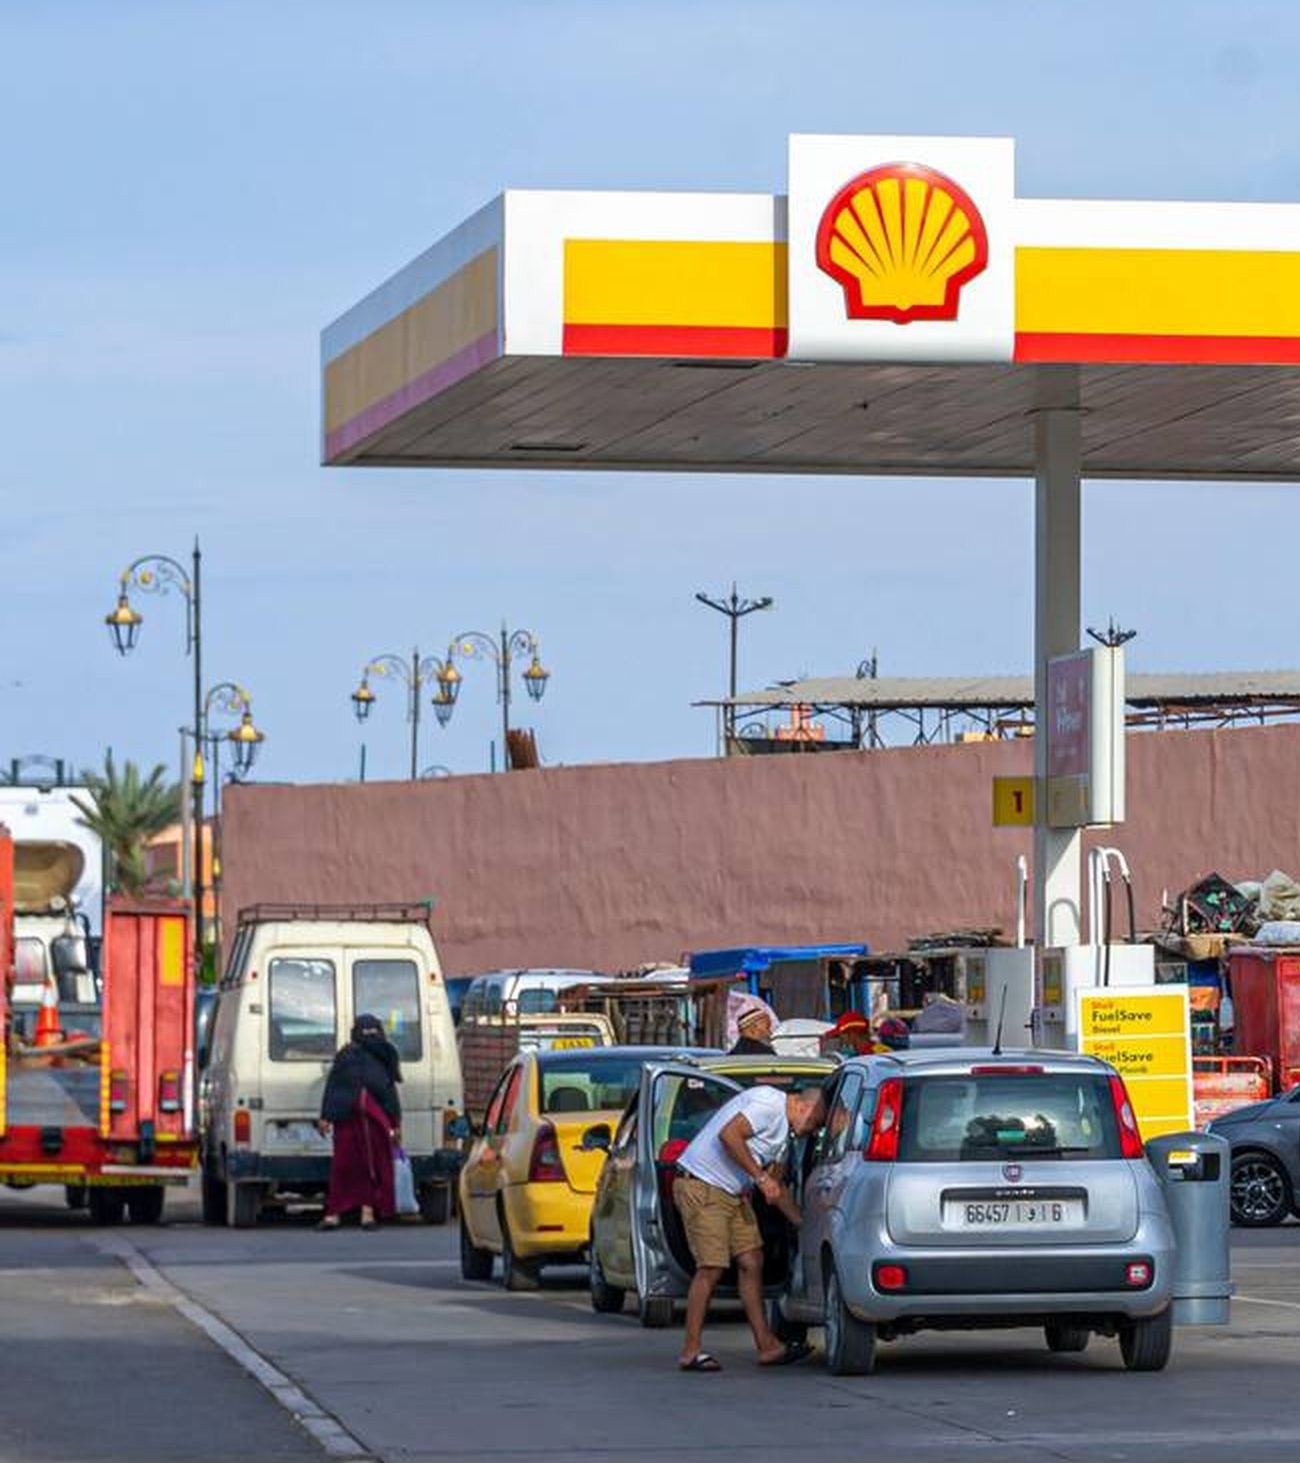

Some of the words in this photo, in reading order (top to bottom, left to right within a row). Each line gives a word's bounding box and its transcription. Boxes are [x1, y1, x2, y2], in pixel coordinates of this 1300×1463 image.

[1012, 790, 1023, 814] 1
[1091, 1009, 1153, 1022] FuelSave
[966, 1203, 1010, 1223] 66457
[1052, 1202, 1062, 1222] 6
